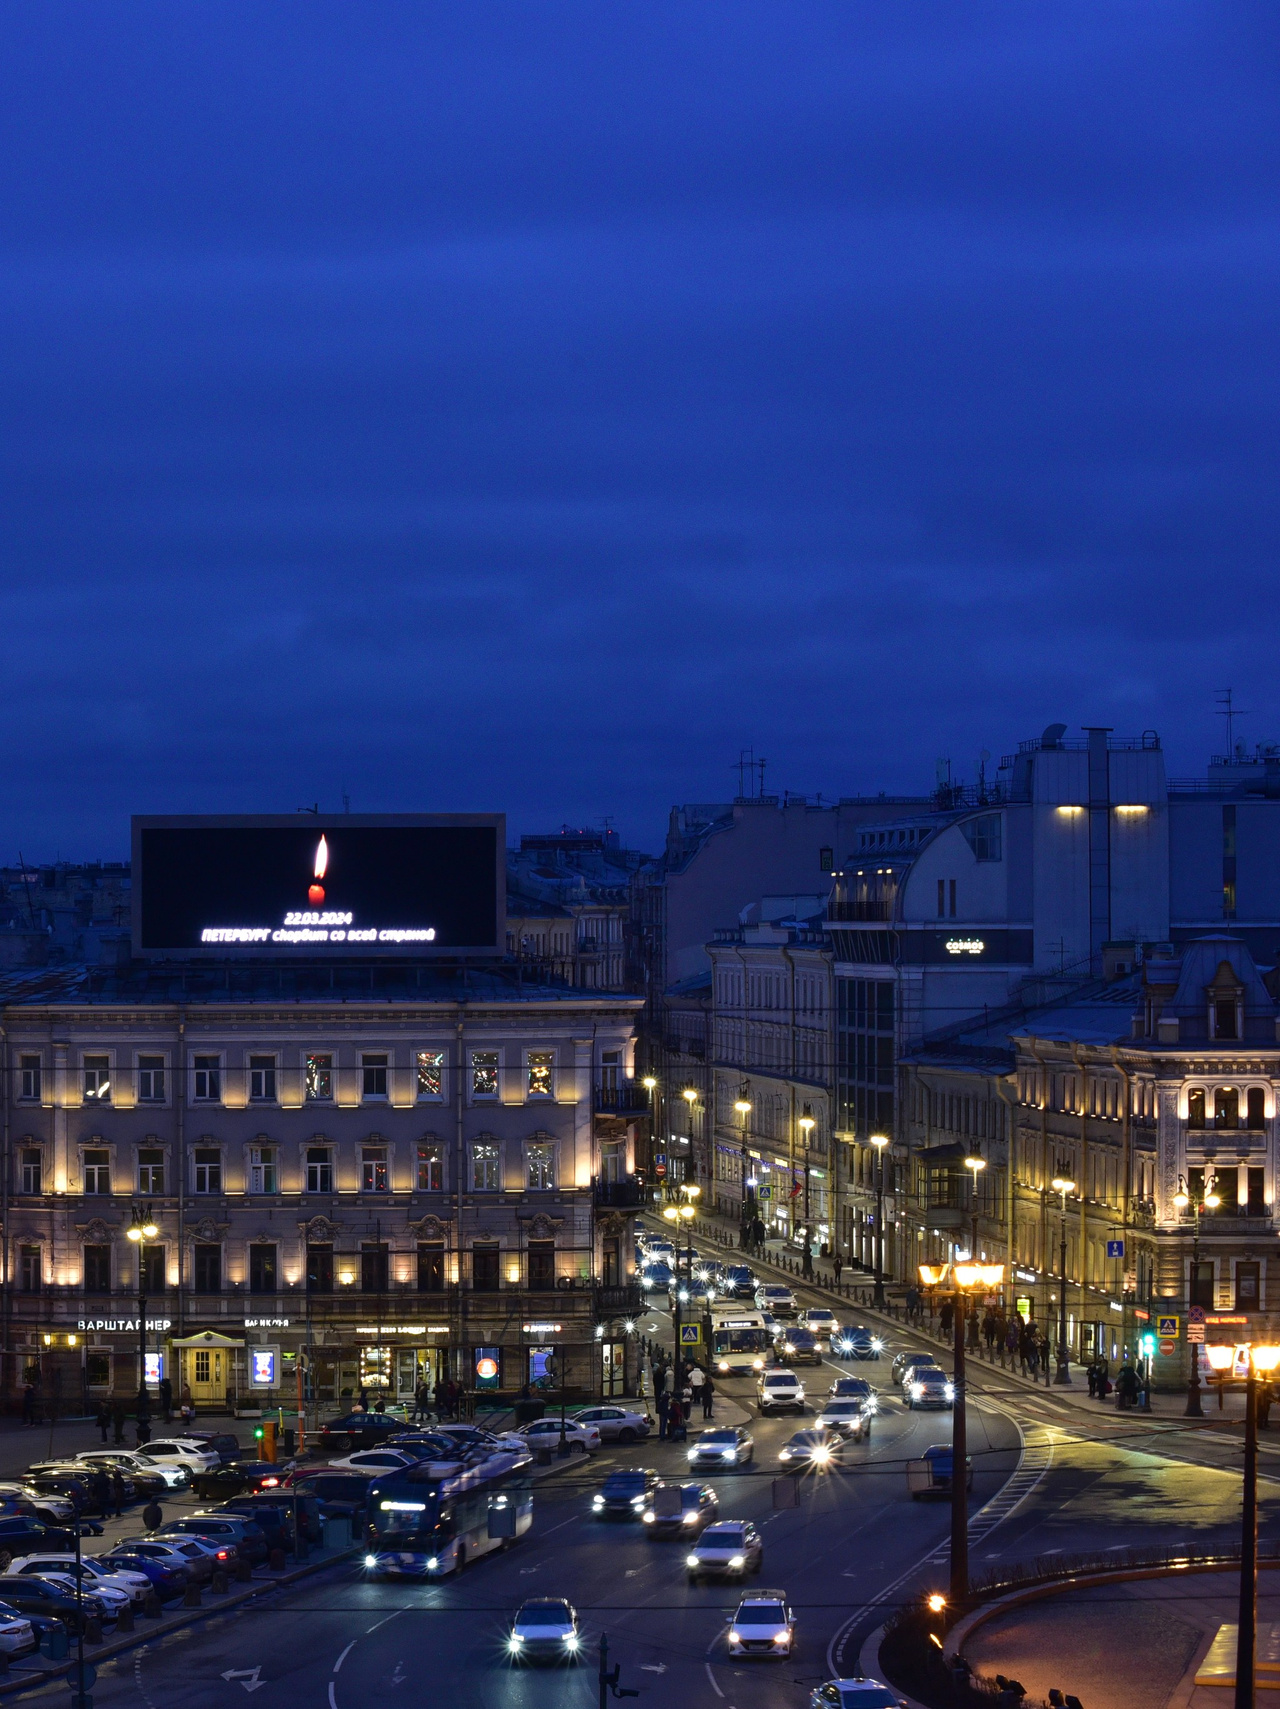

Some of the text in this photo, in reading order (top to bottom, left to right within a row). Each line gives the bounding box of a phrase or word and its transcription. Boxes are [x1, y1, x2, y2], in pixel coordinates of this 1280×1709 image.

[283, 912, 353, 926] 22.03.2024
[200, 928, 271, 943] ПЕТЕРБУРГ
[330, 930, 346, 943] со
[347, 928, 377, 943] всей
[378, 928, 436, 944] страной
[945, 941, 985, 951] COSMOS
